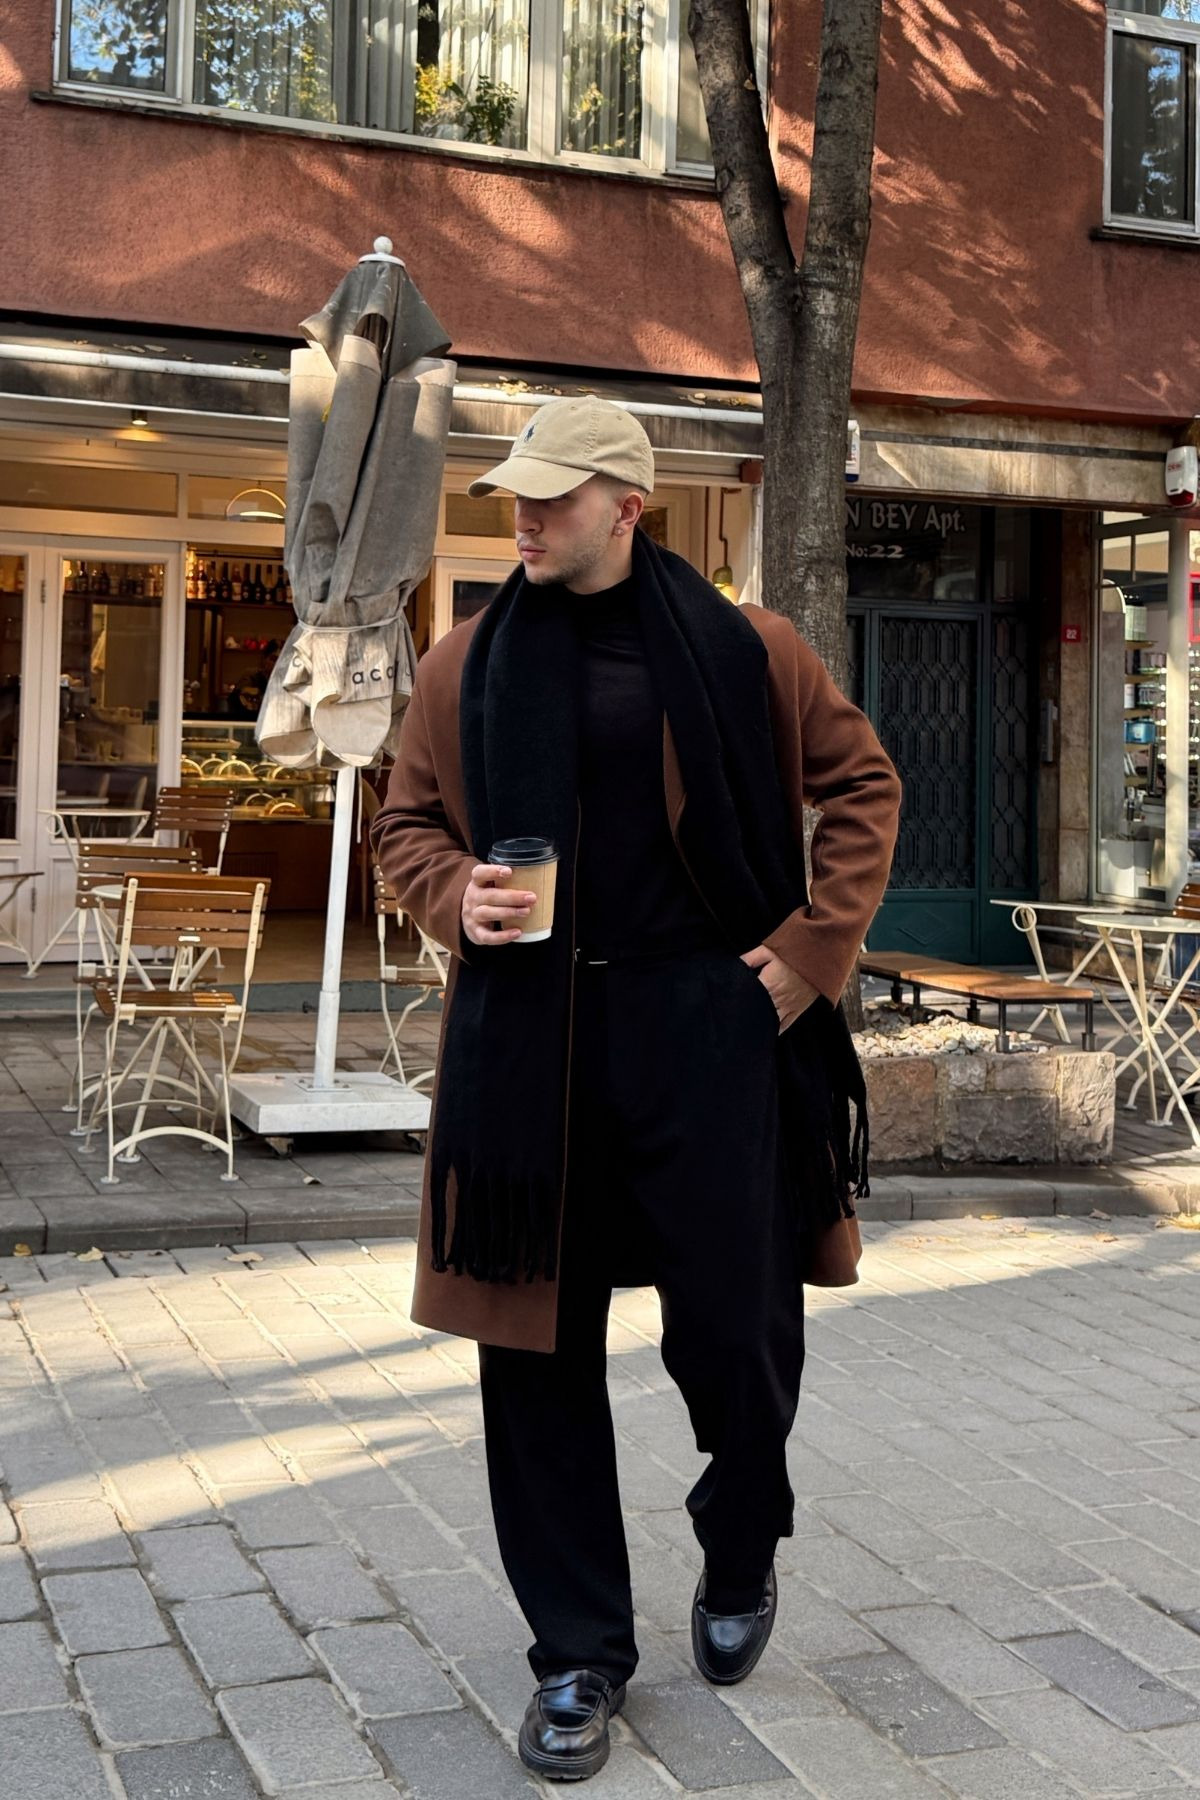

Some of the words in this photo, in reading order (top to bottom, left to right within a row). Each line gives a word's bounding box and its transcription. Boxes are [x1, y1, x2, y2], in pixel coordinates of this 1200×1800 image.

[871, 502, 918, 531] BEY
[923, 504, 965, 539] Apt.
[1066, 629, 1077, 640] 22
